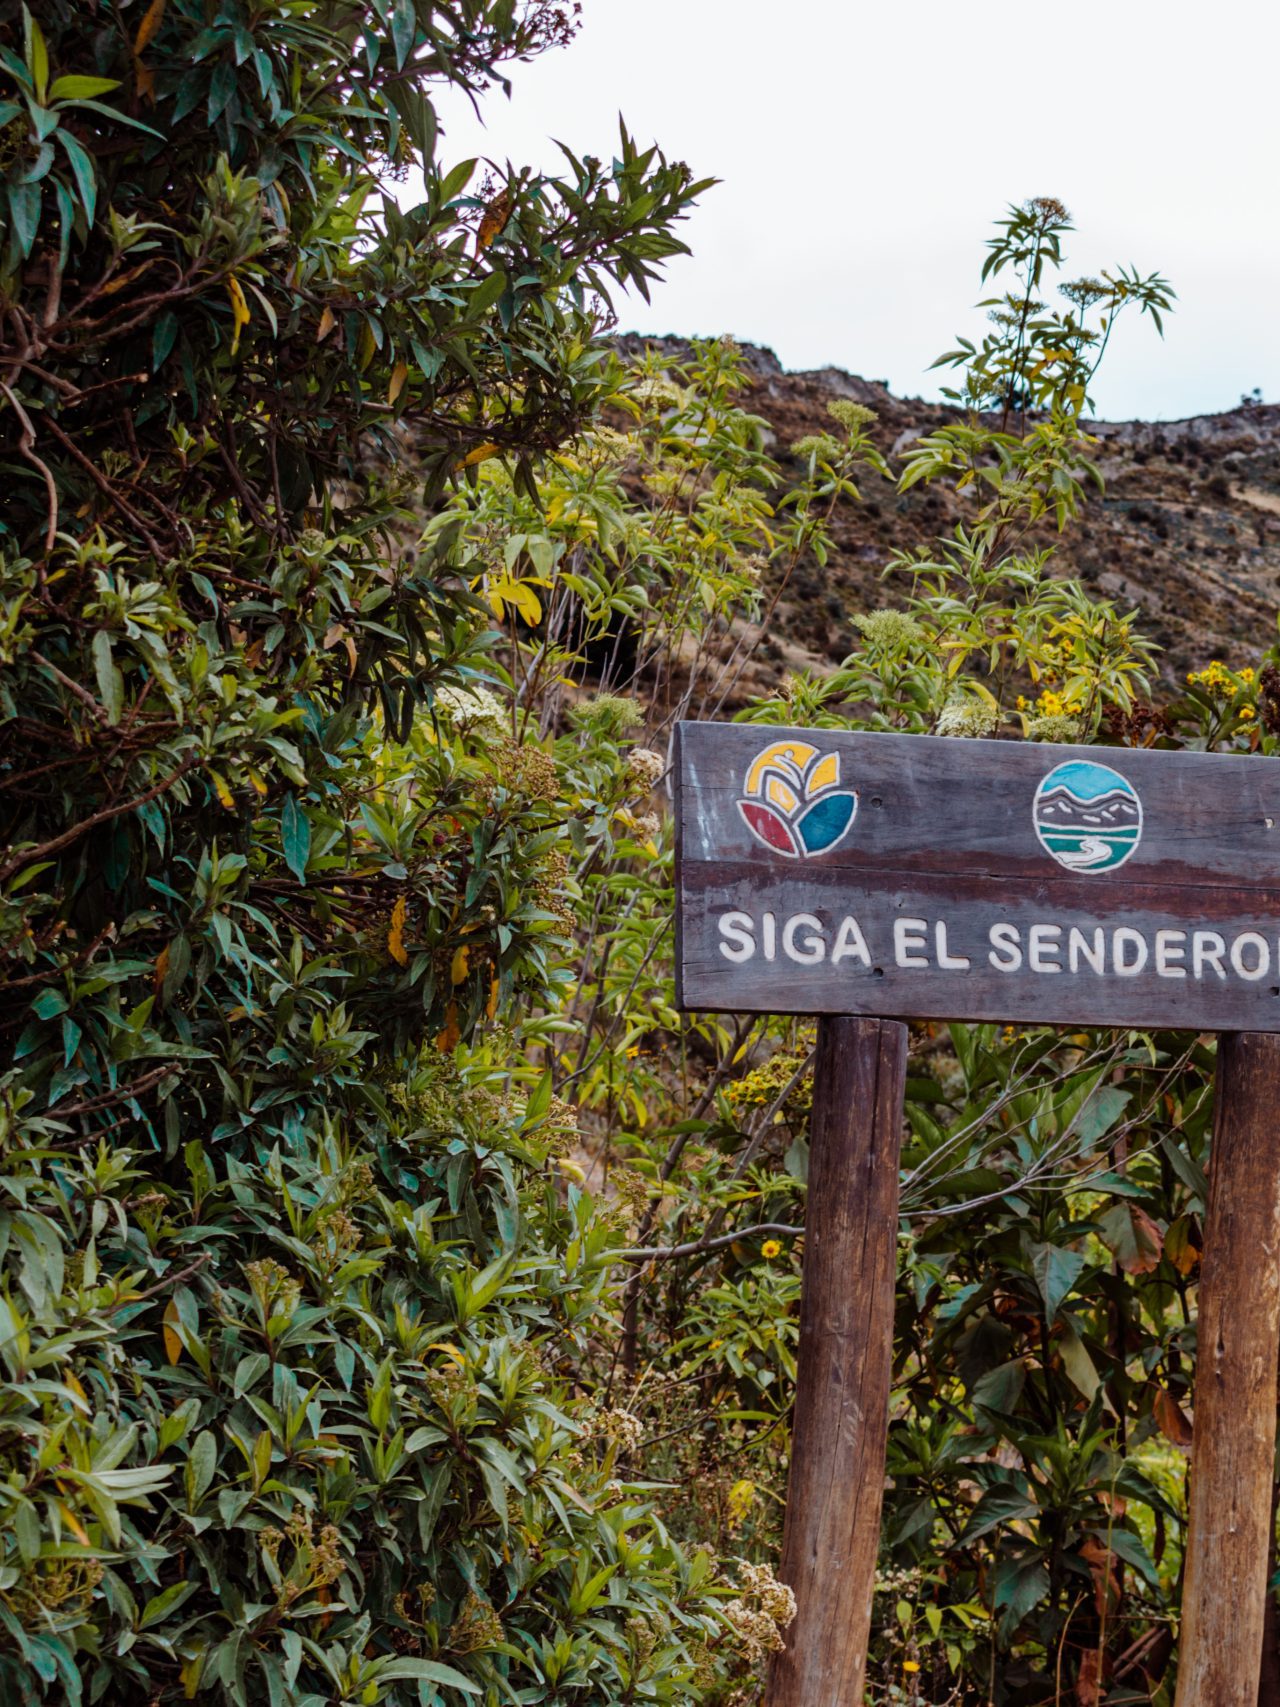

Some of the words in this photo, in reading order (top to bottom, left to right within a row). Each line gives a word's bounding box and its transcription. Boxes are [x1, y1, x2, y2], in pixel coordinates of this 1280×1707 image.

[717, 911, 872, 967] SIGA
[894, 918, 971, 970] EL
[988, 923, 1270, 980] SENDERO
